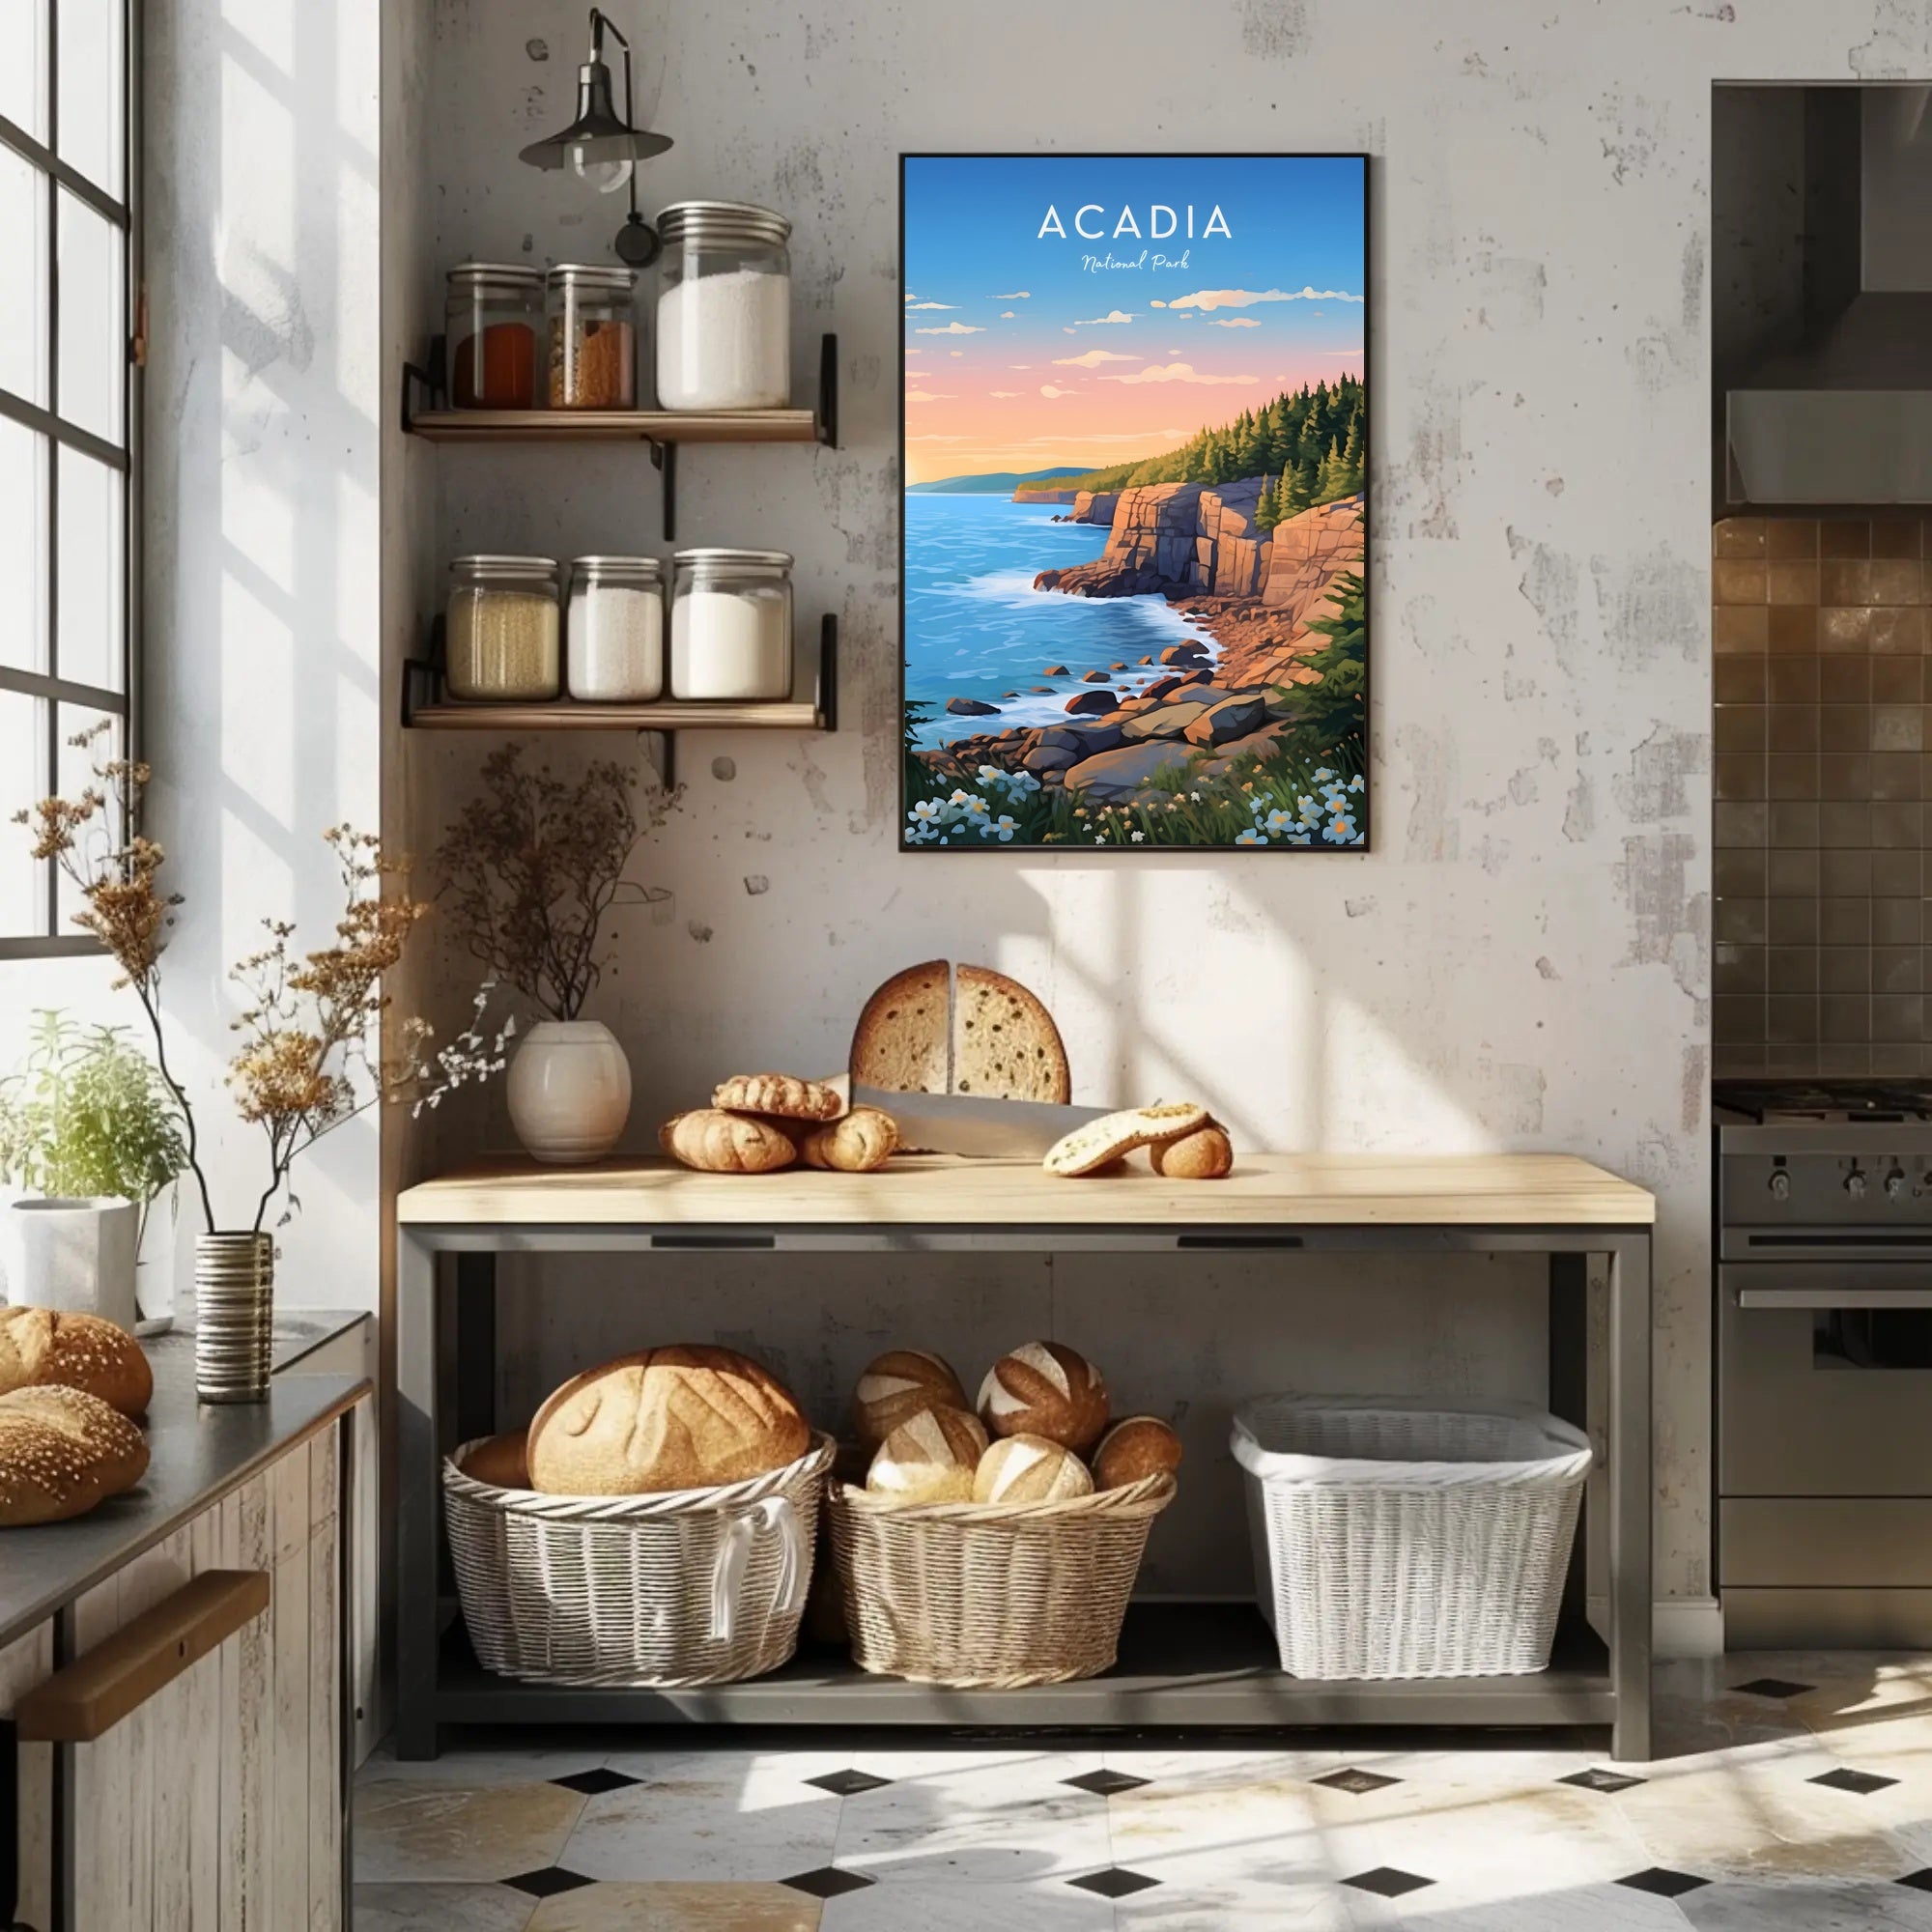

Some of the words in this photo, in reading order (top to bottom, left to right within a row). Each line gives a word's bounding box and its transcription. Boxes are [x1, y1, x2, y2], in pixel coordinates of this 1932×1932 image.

[1037, 204, 1233, 239] ACADIA
[1081, 250, 1148, 272] National
[1151, 249, 1190, 271] Park
